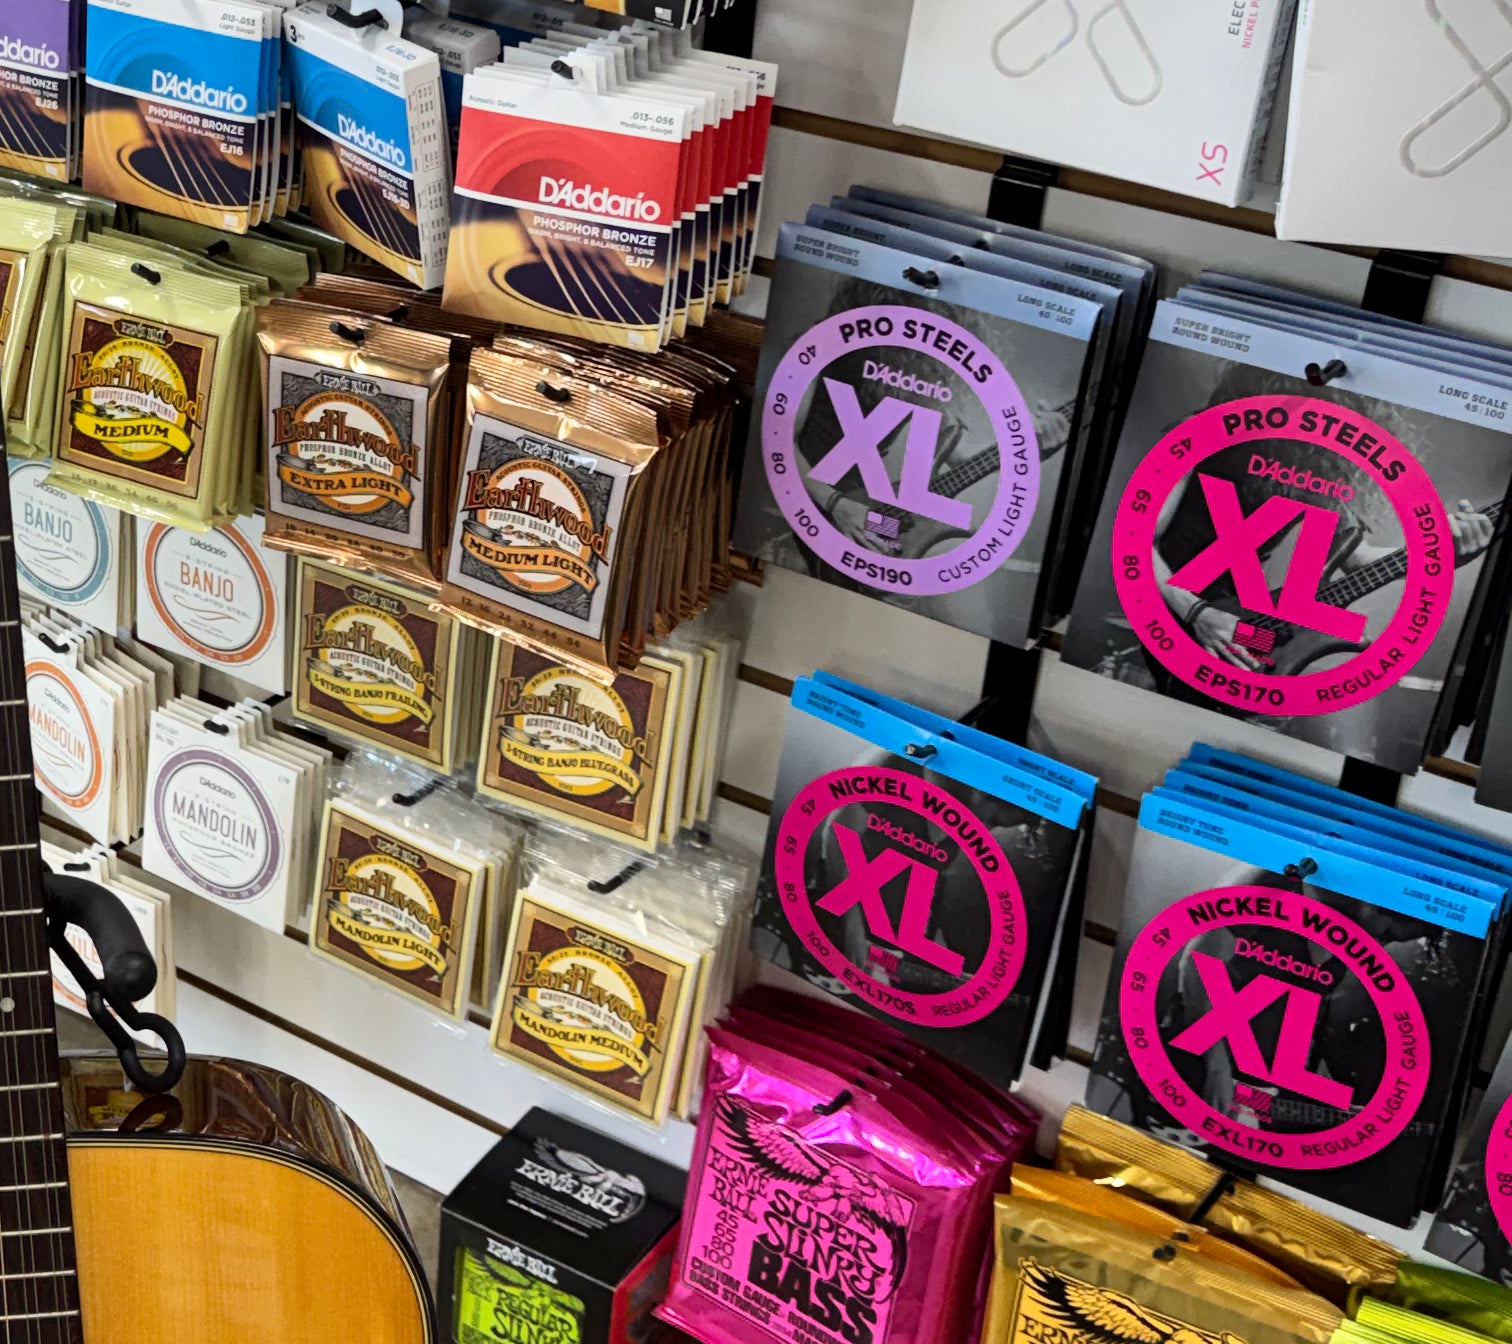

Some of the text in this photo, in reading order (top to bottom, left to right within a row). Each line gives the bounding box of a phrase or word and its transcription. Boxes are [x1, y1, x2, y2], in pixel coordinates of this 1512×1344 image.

[151, 70, 247, 113] D'Addario
[220, 143, 244, 156] EJ16
[338, 114, 406, 167] D'Addario
[1195, 142, 1229, 185] XS
[538, 176, 661, 221] D'Addario
[533, 216, 656, 247] PHOSPHOR BRONZE
[625, 256, 655, 268] EJ17
[839, 316, 992, 384] PRO STEELS
[70, 350, 206, 425] Earthwood
[863, 360, 953, 402] D'Addario
[93, 420, 170, 440] MEDIUM
[273, 404, 419, 478] Earthwood
[806, 376, 973, 531] XL
[1222, 405, 1407, 482] PRO STEELS
[289, 471, 402, 498] EXTRA LIGHT
[1248, 454, 1355, 503] D'Addario
[23, 500, 73, 541] BANJO
[464, 468, 610, 561] Earthwood
[180, 561, 236, 602] BANJO
[468, 537, 594, 585] MEDIUM LIGHT
[841, 551, 913, 586] EPS190
[1166, 471, 1369, 644] XL
[1194, 662, 1285, 706] EPS170
[497, 676, 654, 756] Earthwood
[173, 796, 257, 850] MANDOLIN
[827, 775, 999, 874] NICKEL WOUND
[868, 813, 948, 862] D'Addario
[815, 822, 965, 978] XL
[336, 914, 443, 965] MANDOLIN LIGHT
[1186, 897, 1396, 994] NICKEL WOUND
[1234, 937, 1334, 986] D'Addario
[514, 951, 667, 1045] Earthwood
[842, 967, 916, 1014] EXL170S
[518, 1010, 646, 1067] MANDOLIN MEDIUM
[1168, 949, 1356, 1112] XL
[1201, 1115, 1285, 1158] EXL170
[769, 1190, 878, 1262] SUPER
[497, 1289, 576, 1338] REGULAR
